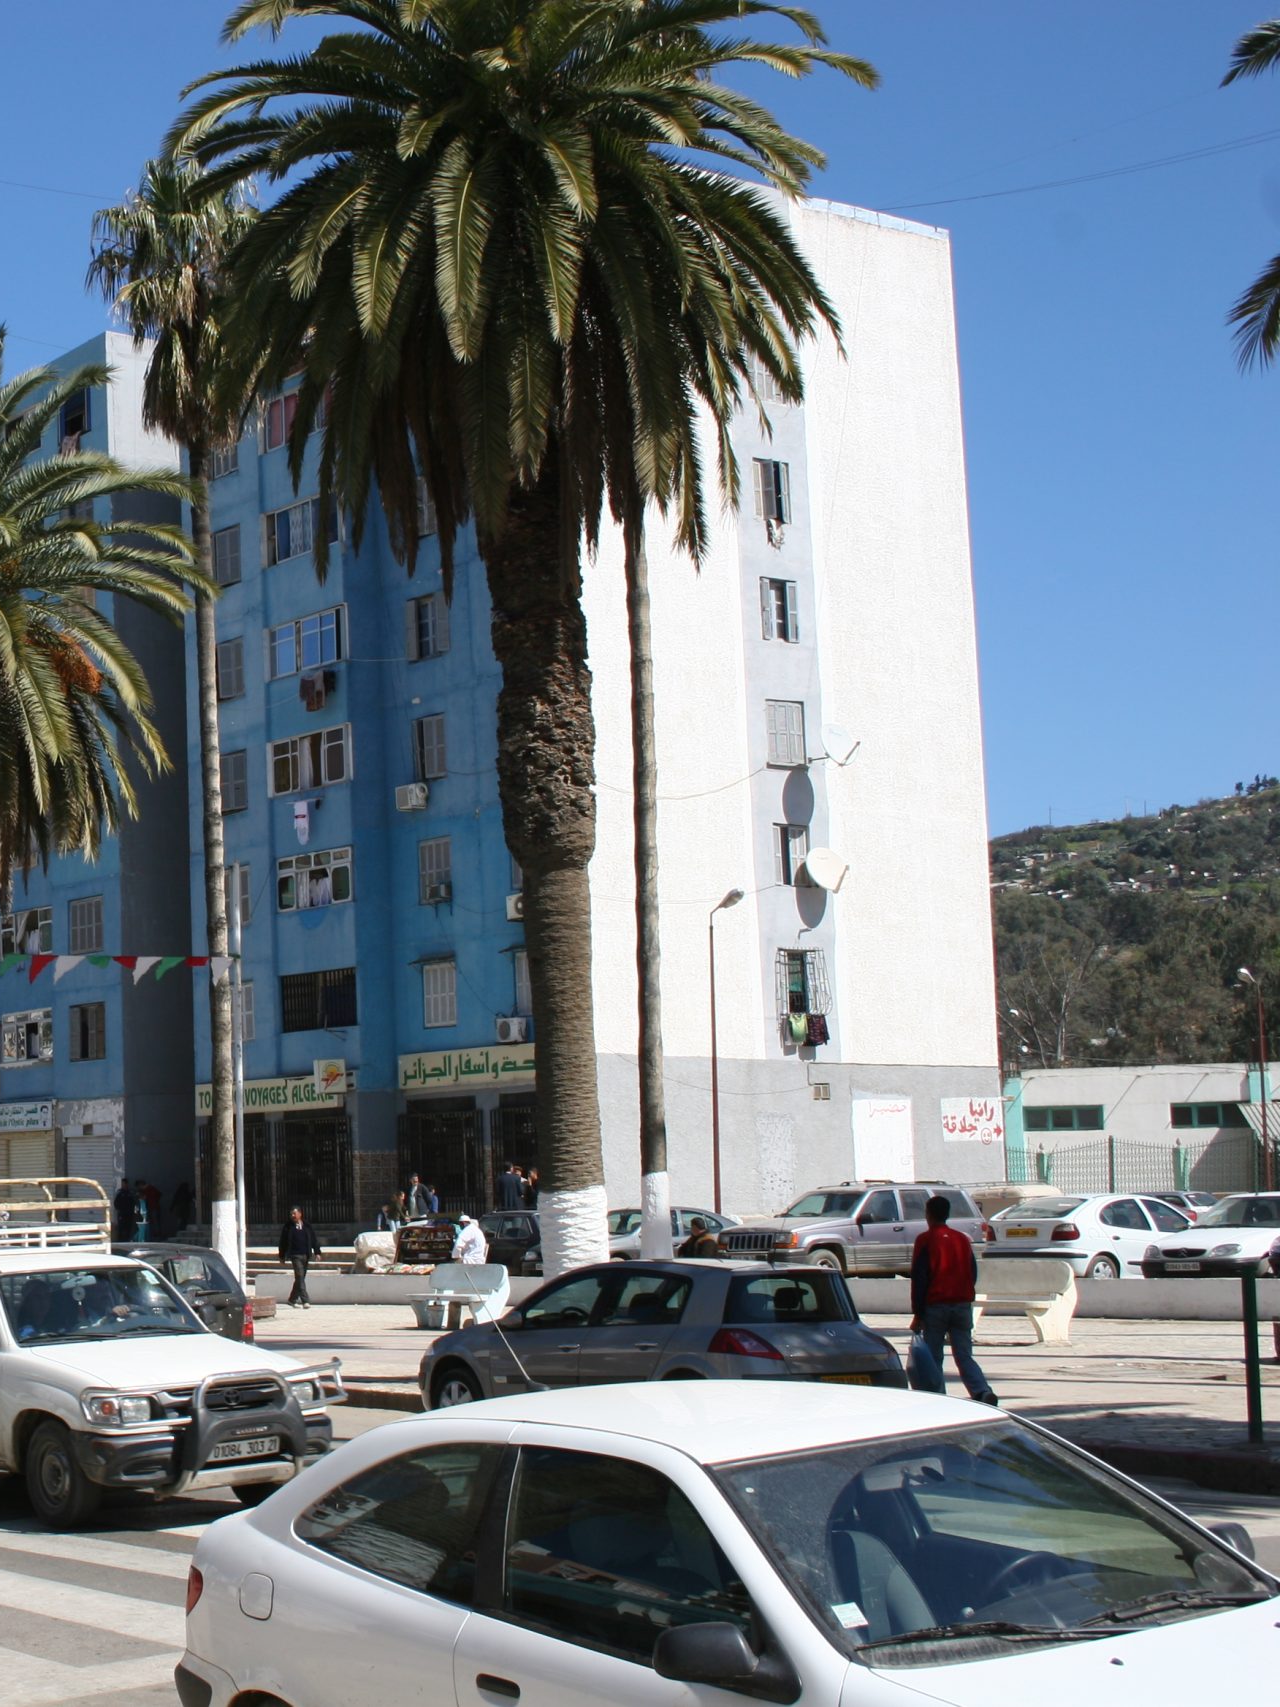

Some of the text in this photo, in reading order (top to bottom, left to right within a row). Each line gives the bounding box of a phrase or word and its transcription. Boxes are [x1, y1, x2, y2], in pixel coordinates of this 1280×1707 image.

[244, 1085, 288, 1107] VOYAGES
[969, 1098, 994, 1122] رانيا
[214, 1444, 241, 1458] 01084
[247, 1441, 264, 1454] 303
